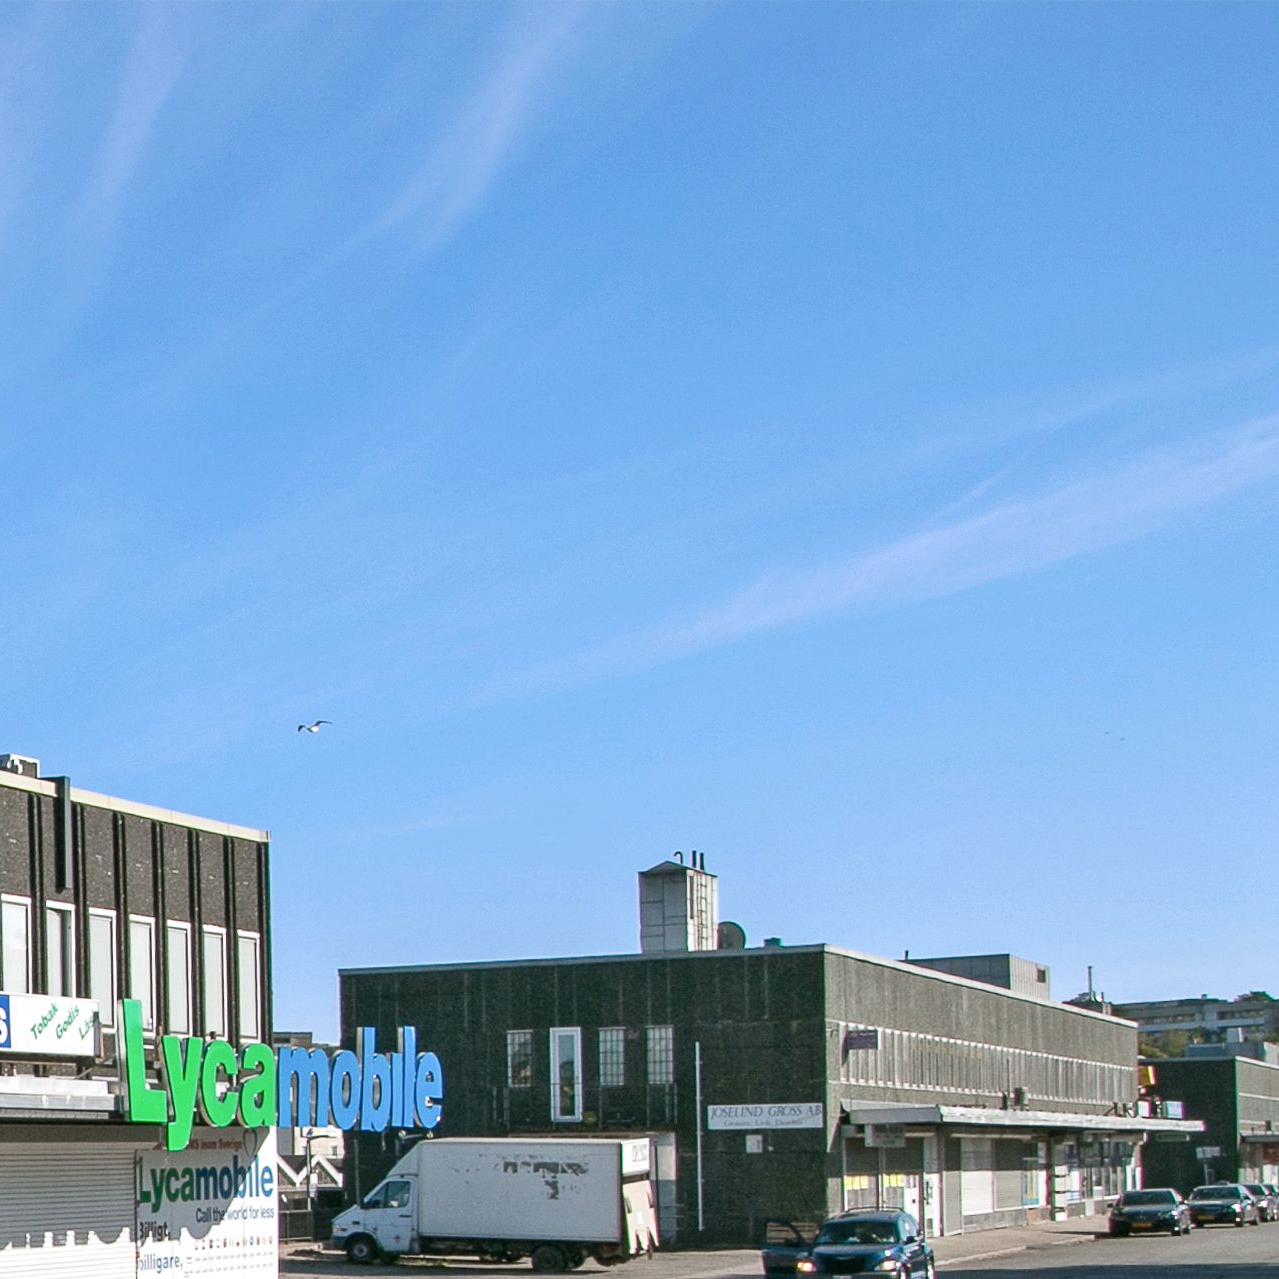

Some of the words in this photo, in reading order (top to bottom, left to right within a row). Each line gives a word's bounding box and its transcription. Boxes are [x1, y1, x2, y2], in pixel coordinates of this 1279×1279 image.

[30, 1002, 59, 1040] Tobak
[55, 1005, 80, 1040] Godis
[119, 998, 443, 1151] Lycamobile
[768, 1105, 803, 1117] GROSS
[806, 1104, 822, 1116] AB
[139, 1154, 275, 1214] Lycamobile
[195, 1207, 212, 1223] Call
[212, 1206, 226, 1221] the
[226, 1206, 248, 1221] world
[249, 1205, 260, 1220] for
[260, 1204, 275, 1219] less
